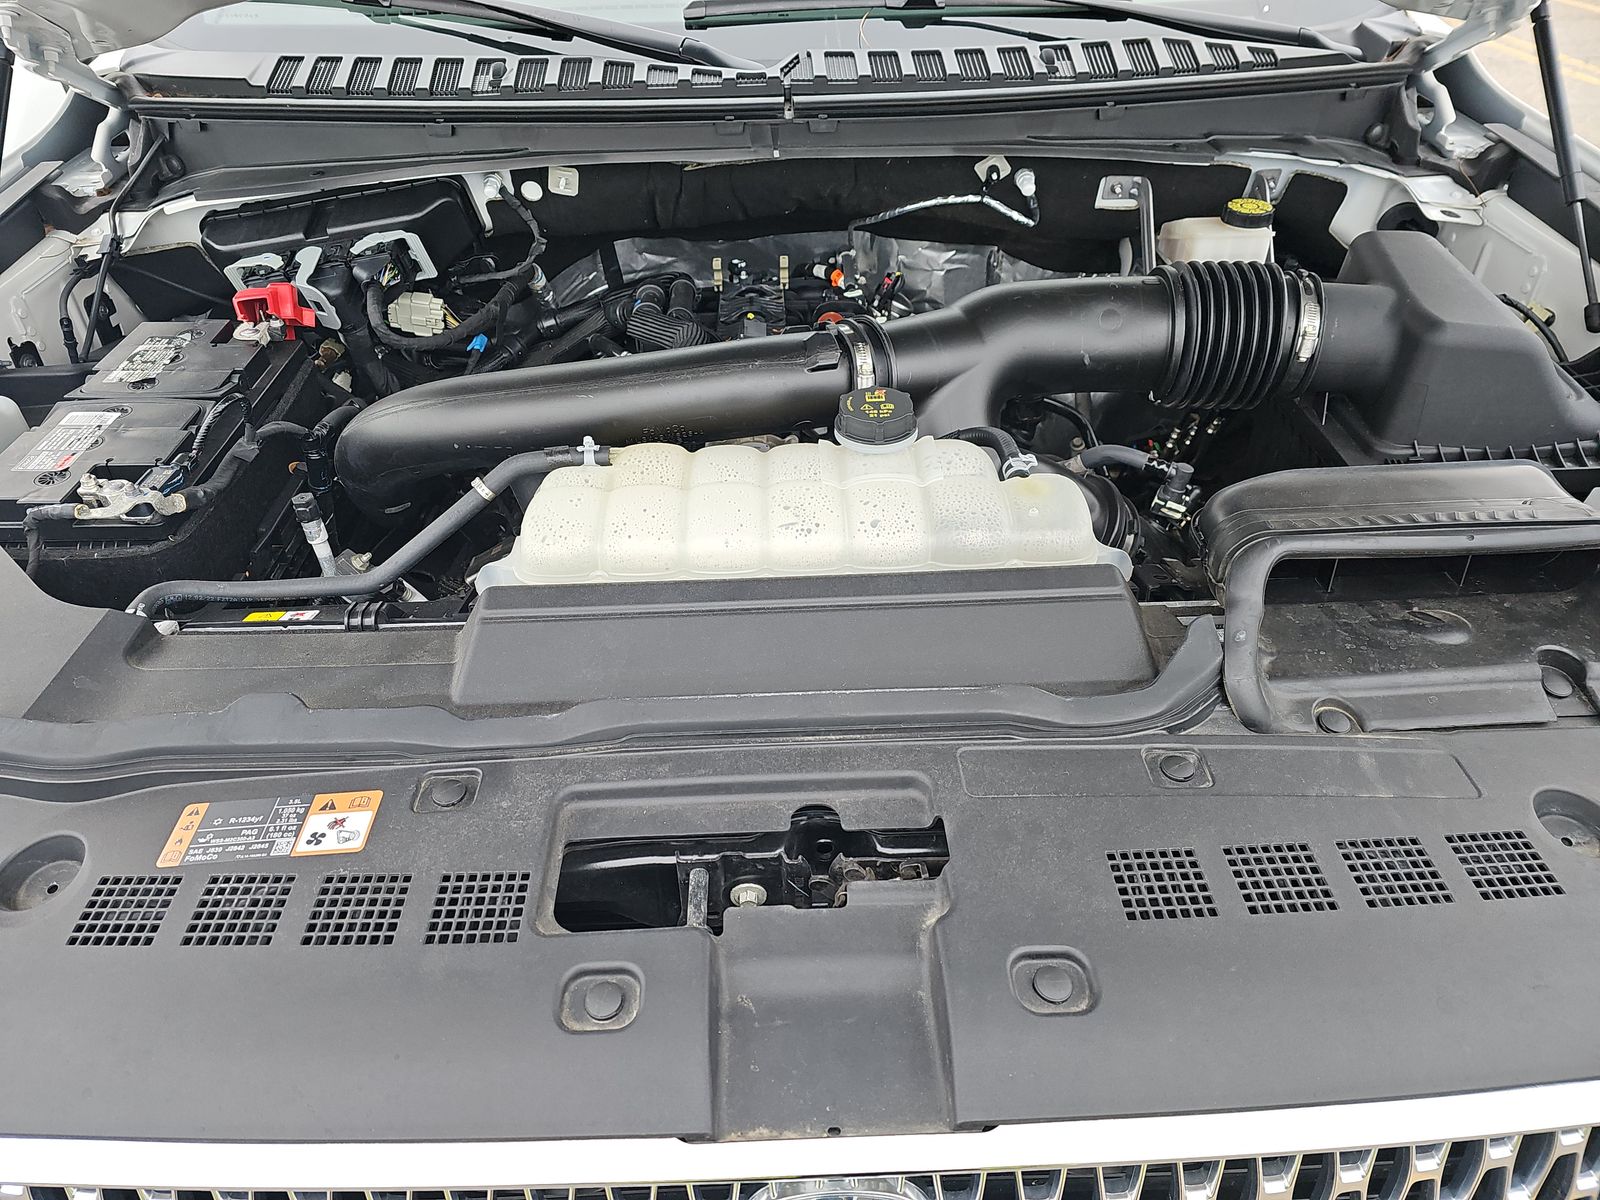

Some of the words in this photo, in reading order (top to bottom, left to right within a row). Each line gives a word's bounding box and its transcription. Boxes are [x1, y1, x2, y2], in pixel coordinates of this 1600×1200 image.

[228, 815, 264, 824] R-1234yf
[240, 828, 259, 836] PAG
[184, 854, 218, 862] FoMoCo
